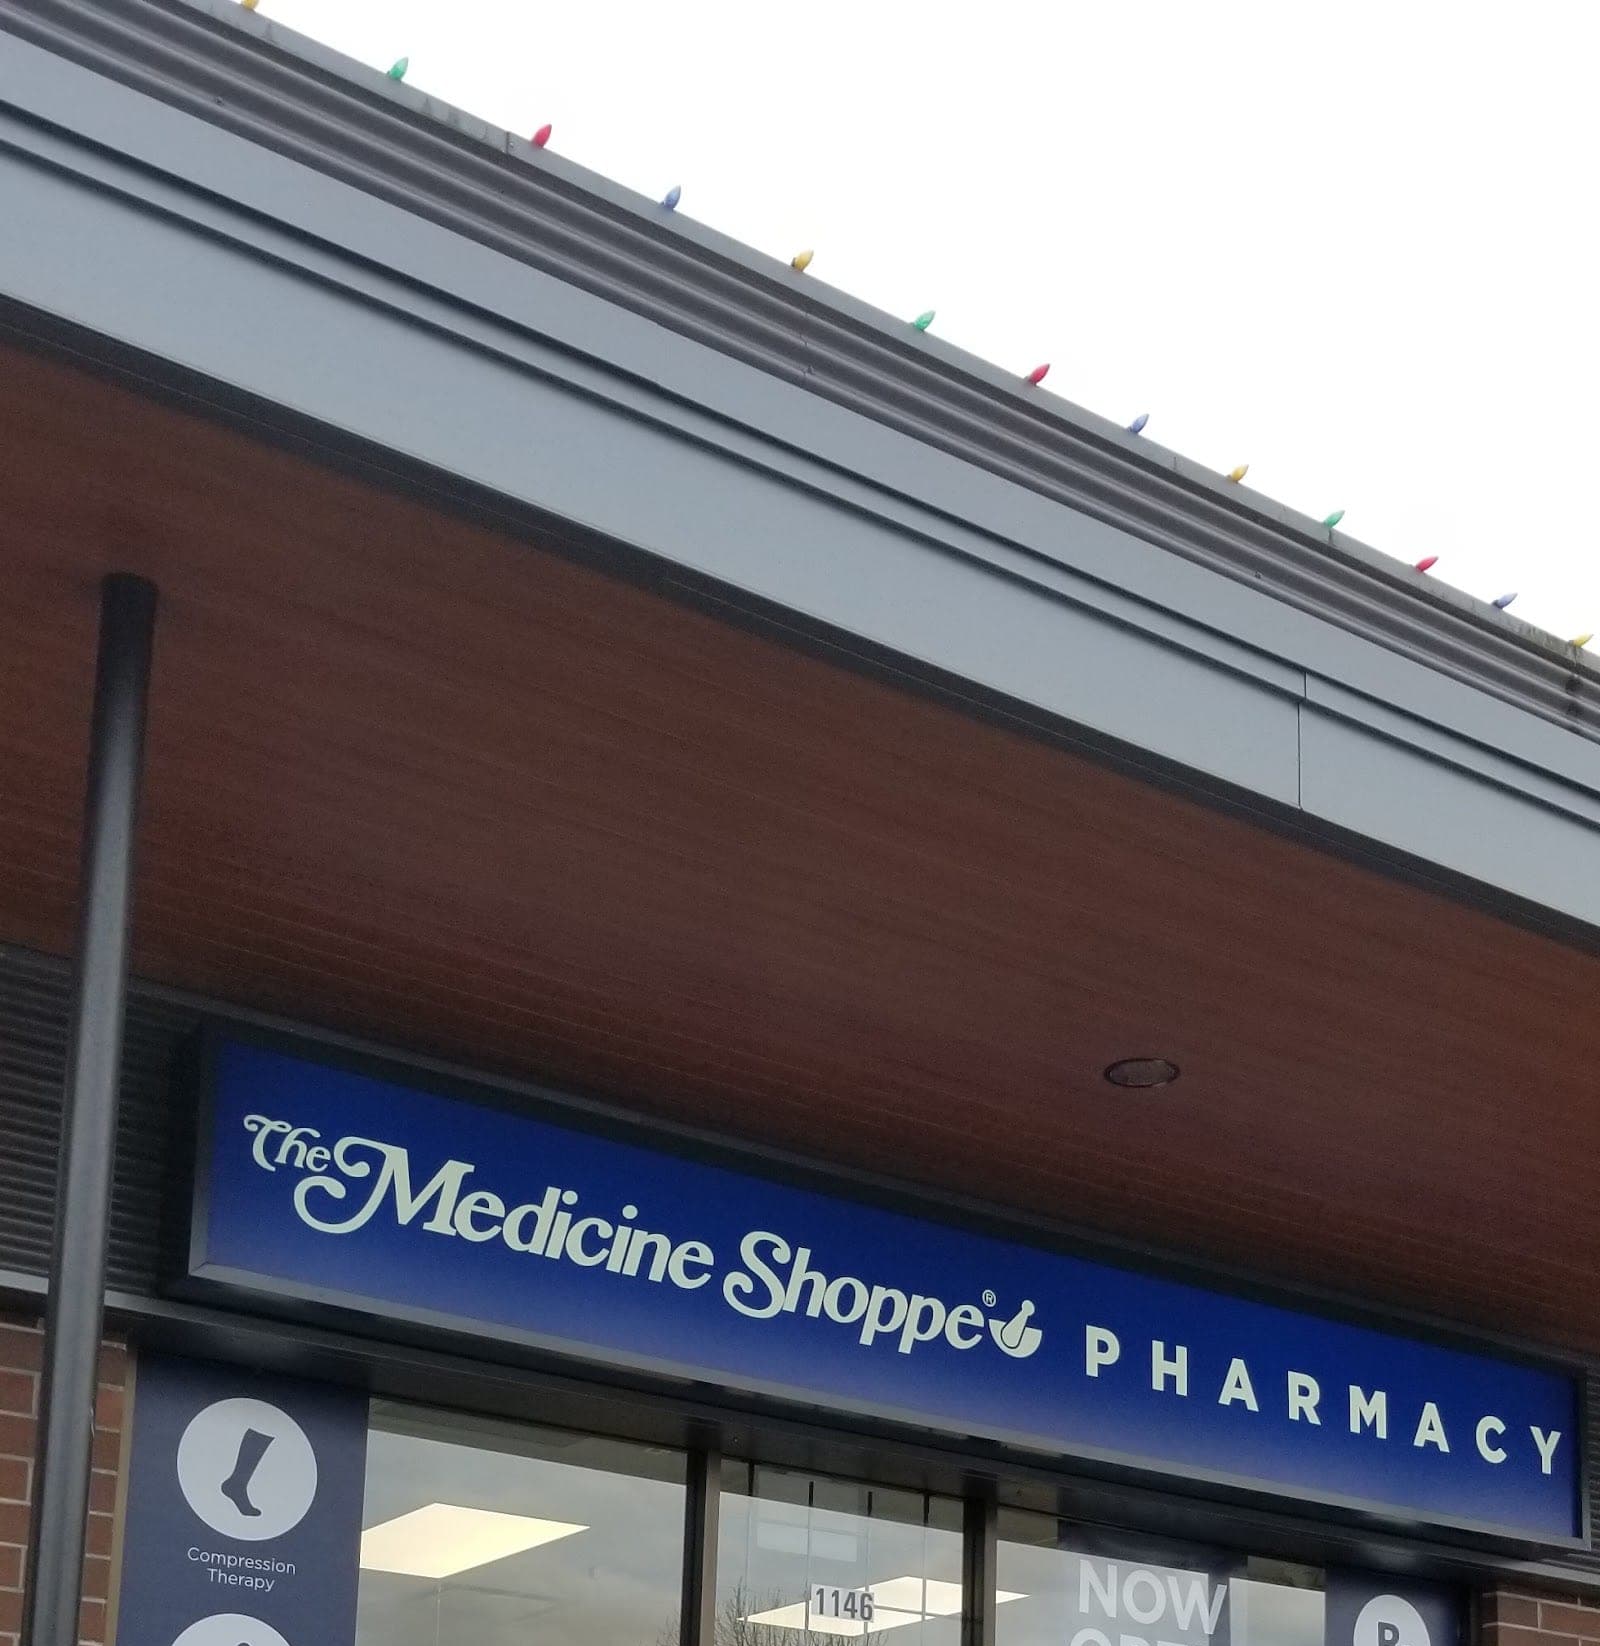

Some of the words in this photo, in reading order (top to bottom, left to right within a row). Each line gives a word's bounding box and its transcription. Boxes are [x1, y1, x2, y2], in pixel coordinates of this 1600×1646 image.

[243, 1114, 331, 1172] The
[294, 1136, 714, 1289] Medicine
[1087, 1325, 1562, 1475] PHARMACY
[187, 1547, 296, 1576] Compression
[206, 1569, 275, 1593] Therapy
[1079, 1559, 1228, 1635] NOW
[816, 1588, 873, 1620] 1146
